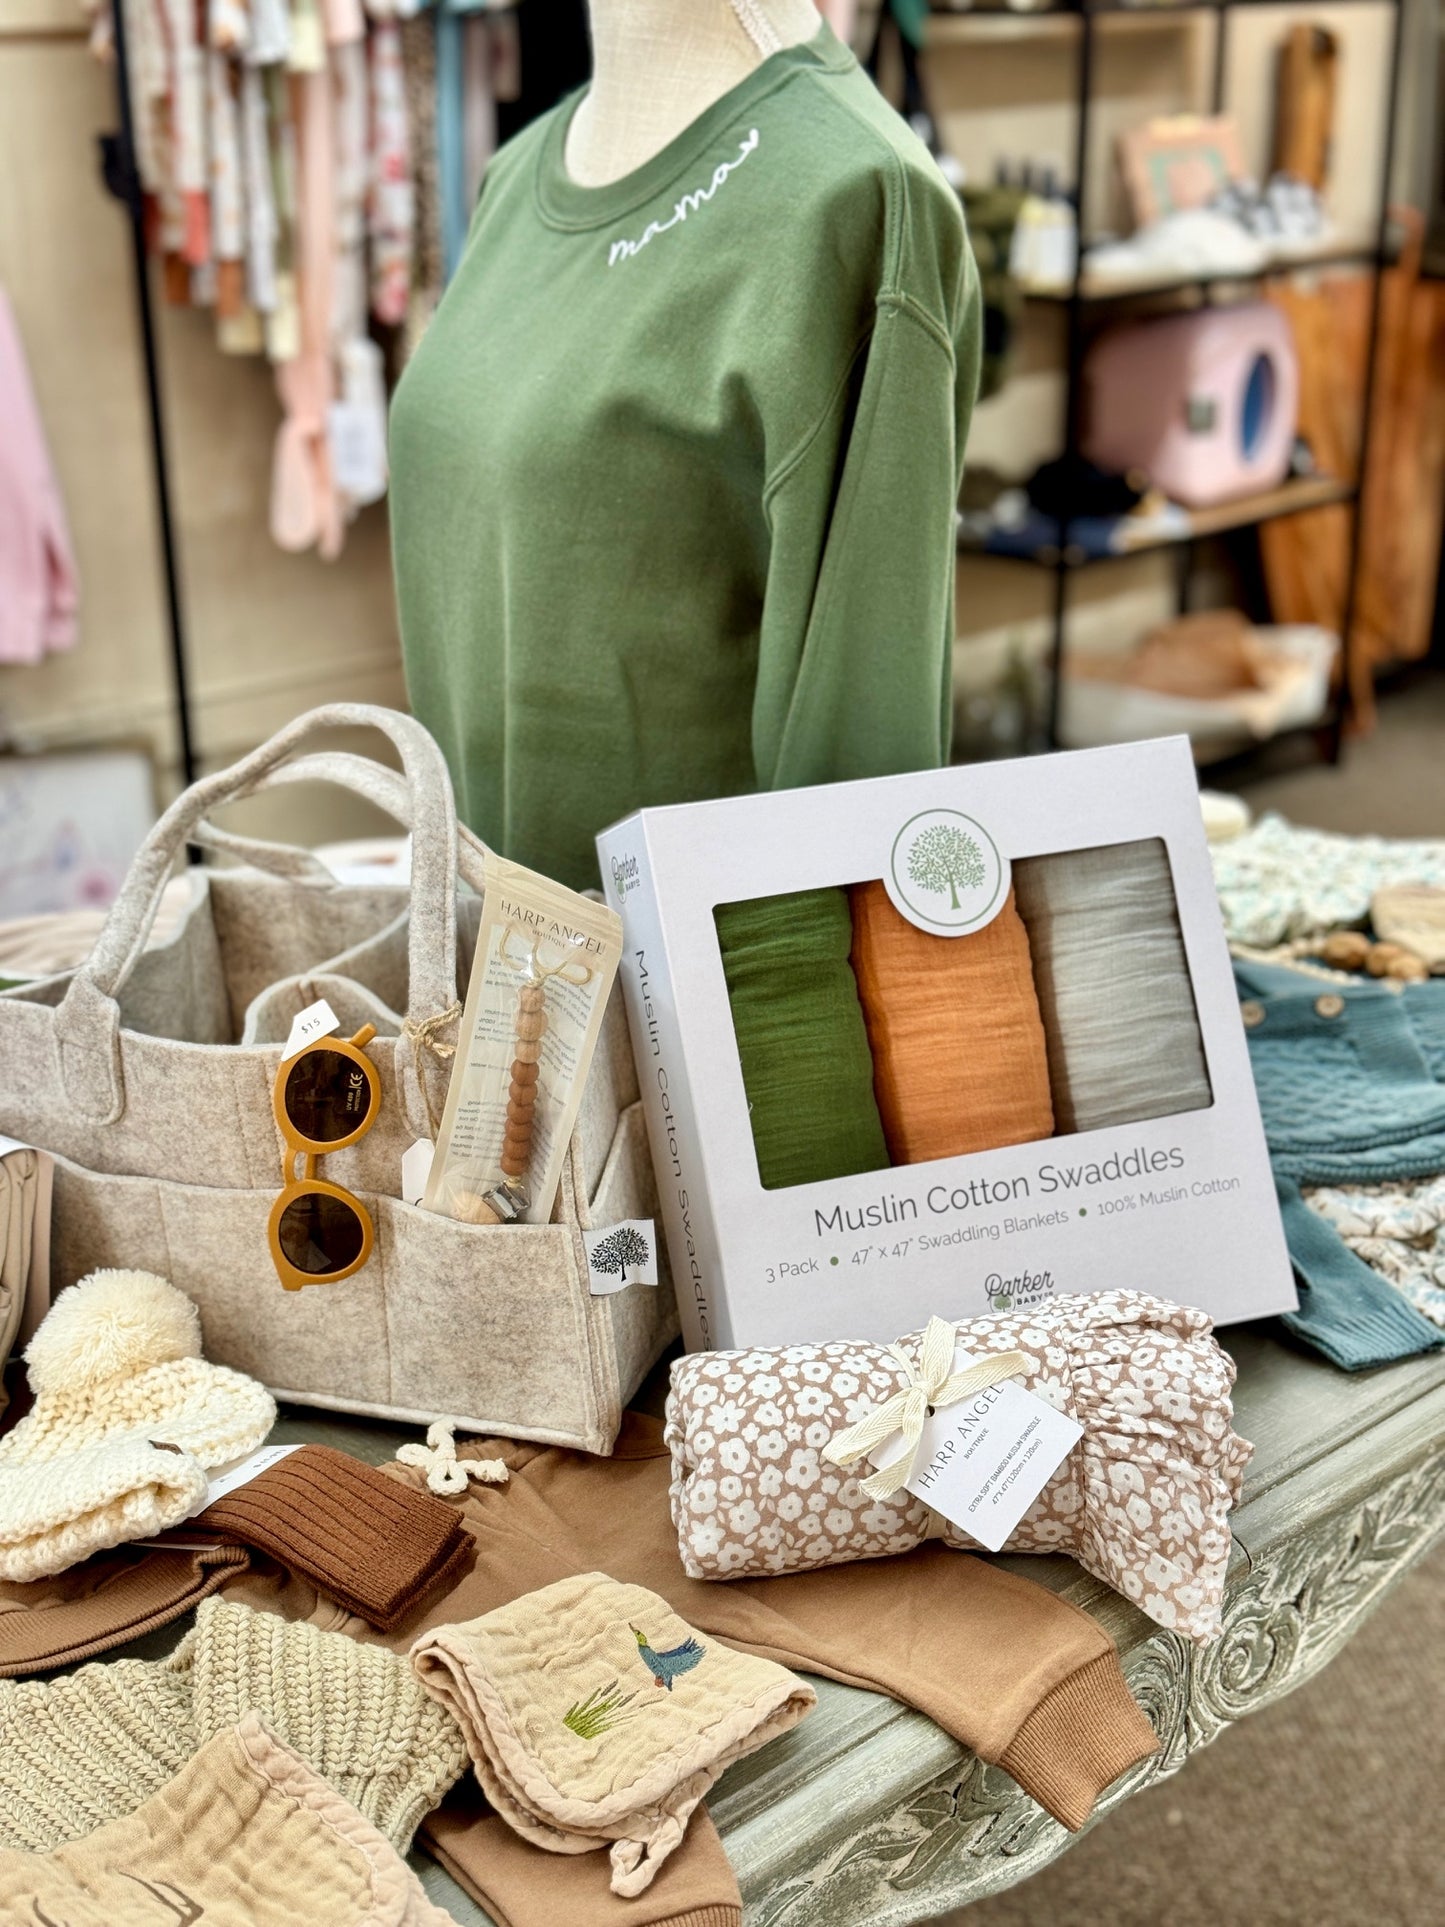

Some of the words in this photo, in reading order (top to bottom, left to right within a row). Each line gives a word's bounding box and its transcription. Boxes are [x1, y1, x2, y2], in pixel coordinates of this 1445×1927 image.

[611, 852, 639, 886] Parker
[501, 900, 545, 927] HARP
[550, 922, 606, 955] ANGEL
[532, 929, 567, 949] BOUTIQUE
[636, 950, 661, 1057] Muslin
[657, 1067, 683, 1178] Cotton
[678, 1189, 713, 1351] Swaddles
[814, 1194, 918, 1237] Muslin
[926, 1178, 1030, 1214] Cotton
[1038, 1146, 1185, 1193] Swaddles
[765, 1268, 776, 1284] 3
[779, 1257, 820, 1279] Pack
[918, 1225, 1001, 1251] Swaddling
[1003, 1209, 1070, 1235] Blankets
[1097, 1194, 1137, 1217] 100%
[1140, 1185, 1189, 1208] Muslin
[1191, 1176, 1241, 1198] Cotton
[984, 1269, 1055, 1302] Parker
[1017, 1293, 1043, 1306] BABY
[918, 1440, 957, 1489] HARP
[957, 1385, 1005, 1440] ANGEL
[963, 1427, 990, 1461] BOUTIQUE
[968, 1494, 984, 1513] EXTRA
[980, 1479, 995, 1496] SOFT
[990, 1458, 1010, 1482] BAMBOO
[1006, 1439, 1024, 1461] MUSLIN
[1020, 1415, 1042, 1442] SWADDLE
